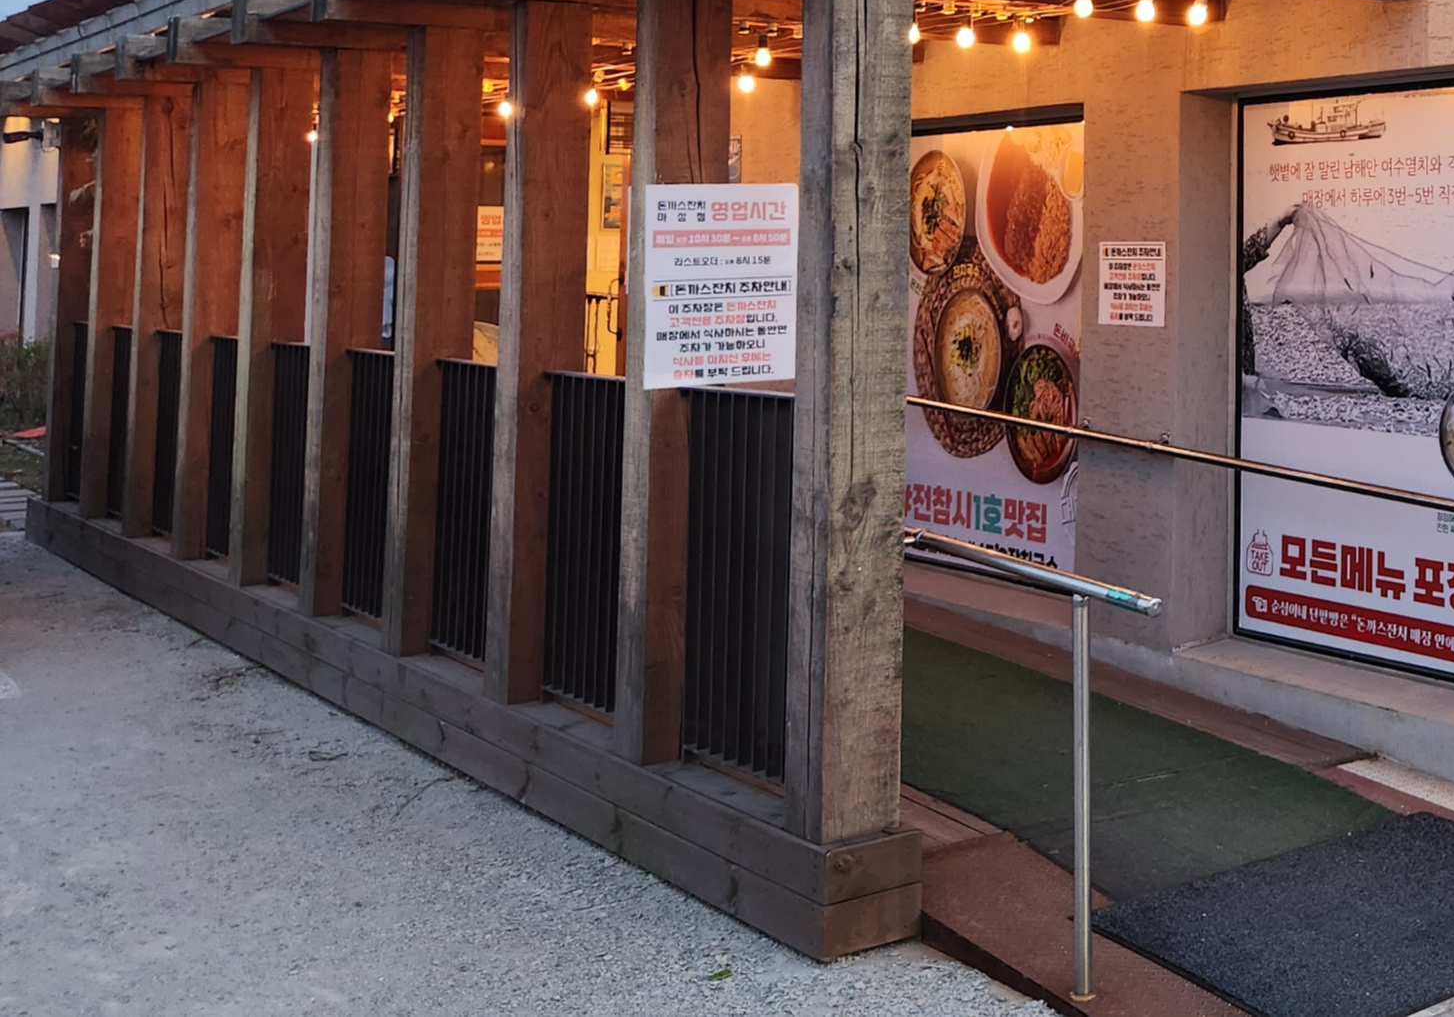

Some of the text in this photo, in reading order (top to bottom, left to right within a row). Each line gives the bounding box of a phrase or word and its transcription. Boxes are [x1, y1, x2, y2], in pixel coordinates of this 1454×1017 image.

[1269, 162, 1301, 183] 햇볕에
[1304, 161, 1315, 181] 잘
[1318, 160, 1340, 181] 말린
[1343, 158, 1378, 179] 남해안
[1381, 154, 1443, 178] 여수멸치와
[1302, 188, 1346, 209] 매장에서
[1350, 186, 1385, 207] 하루에
[710, 201, 787, 222] 영업시간
[688, 234, 709, 243] 10시
[736, 256, 750, 265] 8시
[752, 256, 771, 265] 15분
[668, 304, 679, 314] 이
[681, 302, 723, 314] 주차장은
[1251, 549, 1270, 562] TAKE
[1252, 560, 1267, 572] OUT
[1279, 534, 1406, 601] 모든메뉴
[1271, 599, 1307, 620] 순심이네
[1410, 627, 1432, 647] 매장
